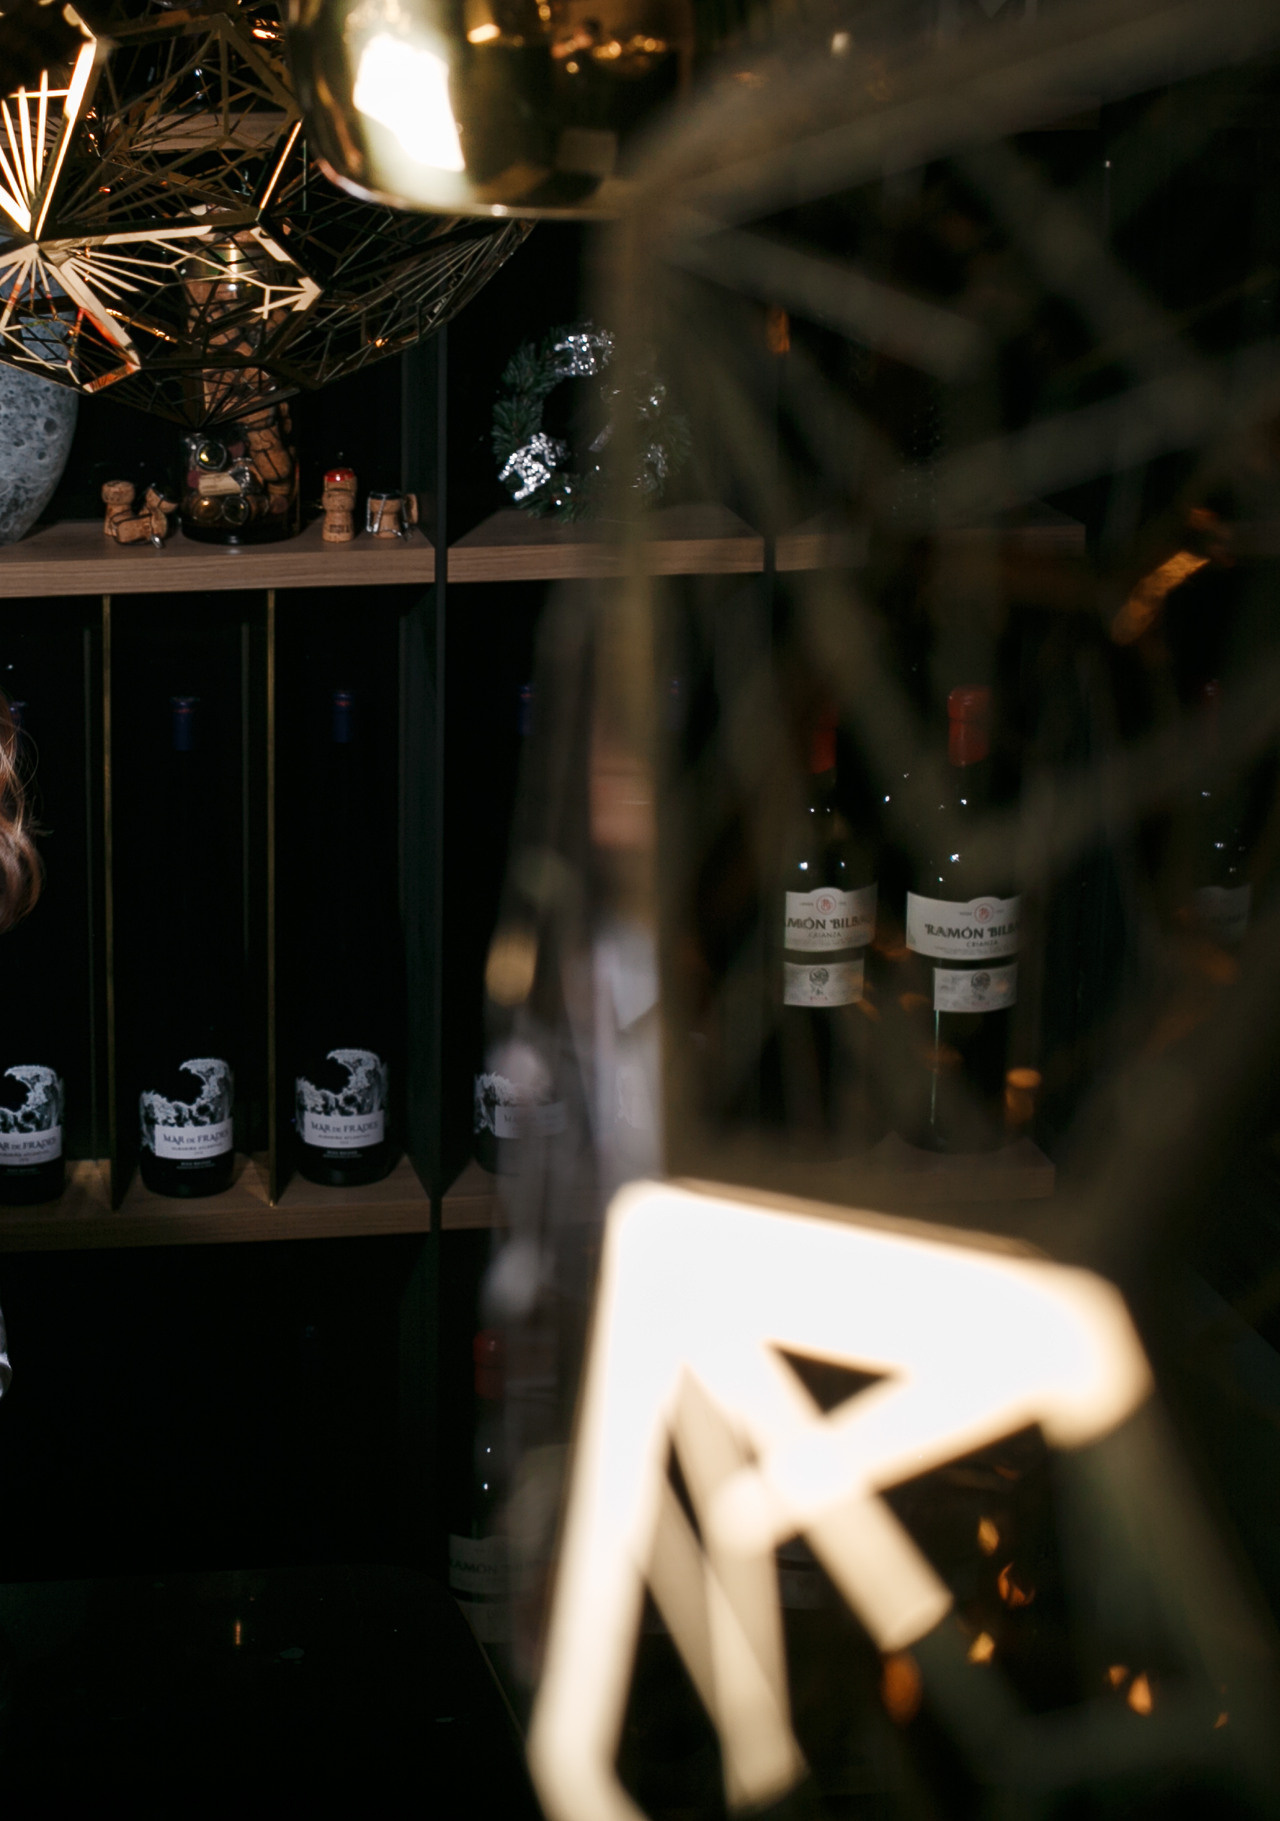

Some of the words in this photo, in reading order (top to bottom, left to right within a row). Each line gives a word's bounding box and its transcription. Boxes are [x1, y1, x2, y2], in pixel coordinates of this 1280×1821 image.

[924, 923, 984, 939] RAMÓN
[312, 1122, 330, 1133] MAR
[163, 1134, 184, 1145] MAR
